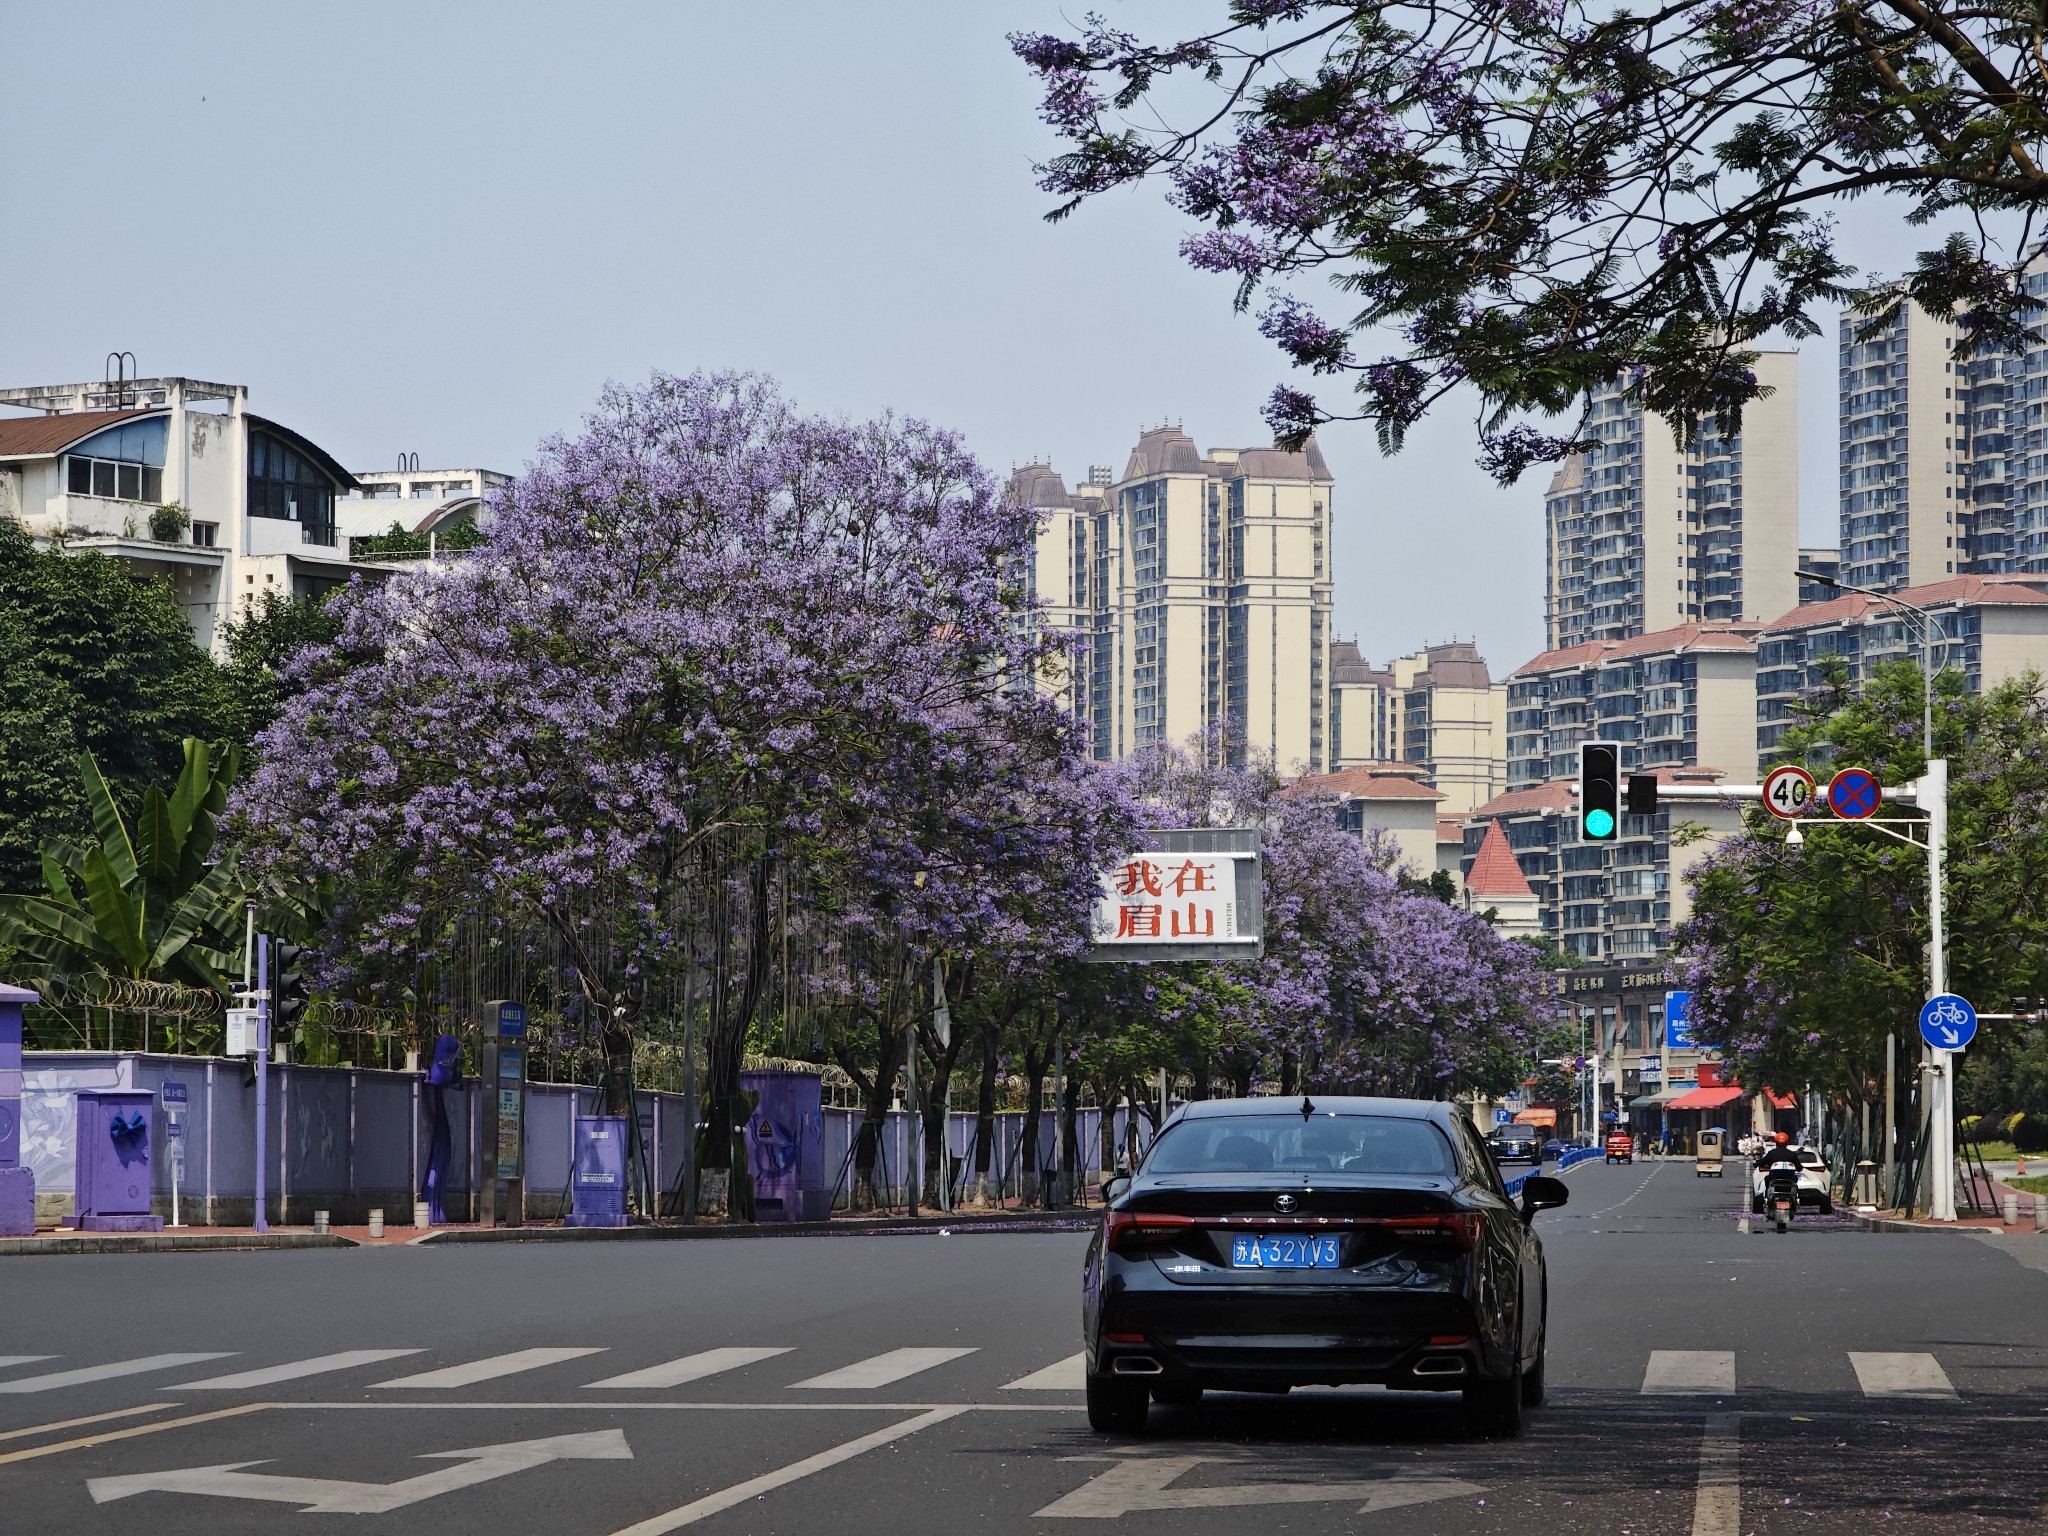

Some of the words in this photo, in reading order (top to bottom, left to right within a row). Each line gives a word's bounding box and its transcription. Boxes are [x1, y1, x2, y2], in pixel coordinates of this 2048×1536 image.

[1773, 778, 1806, 806] 40
[1112, 858, 1216, 897] 我在
[1115, 902, 1214, 939] 眉山
[1219, 1217, 1354, 1225] AVALON
